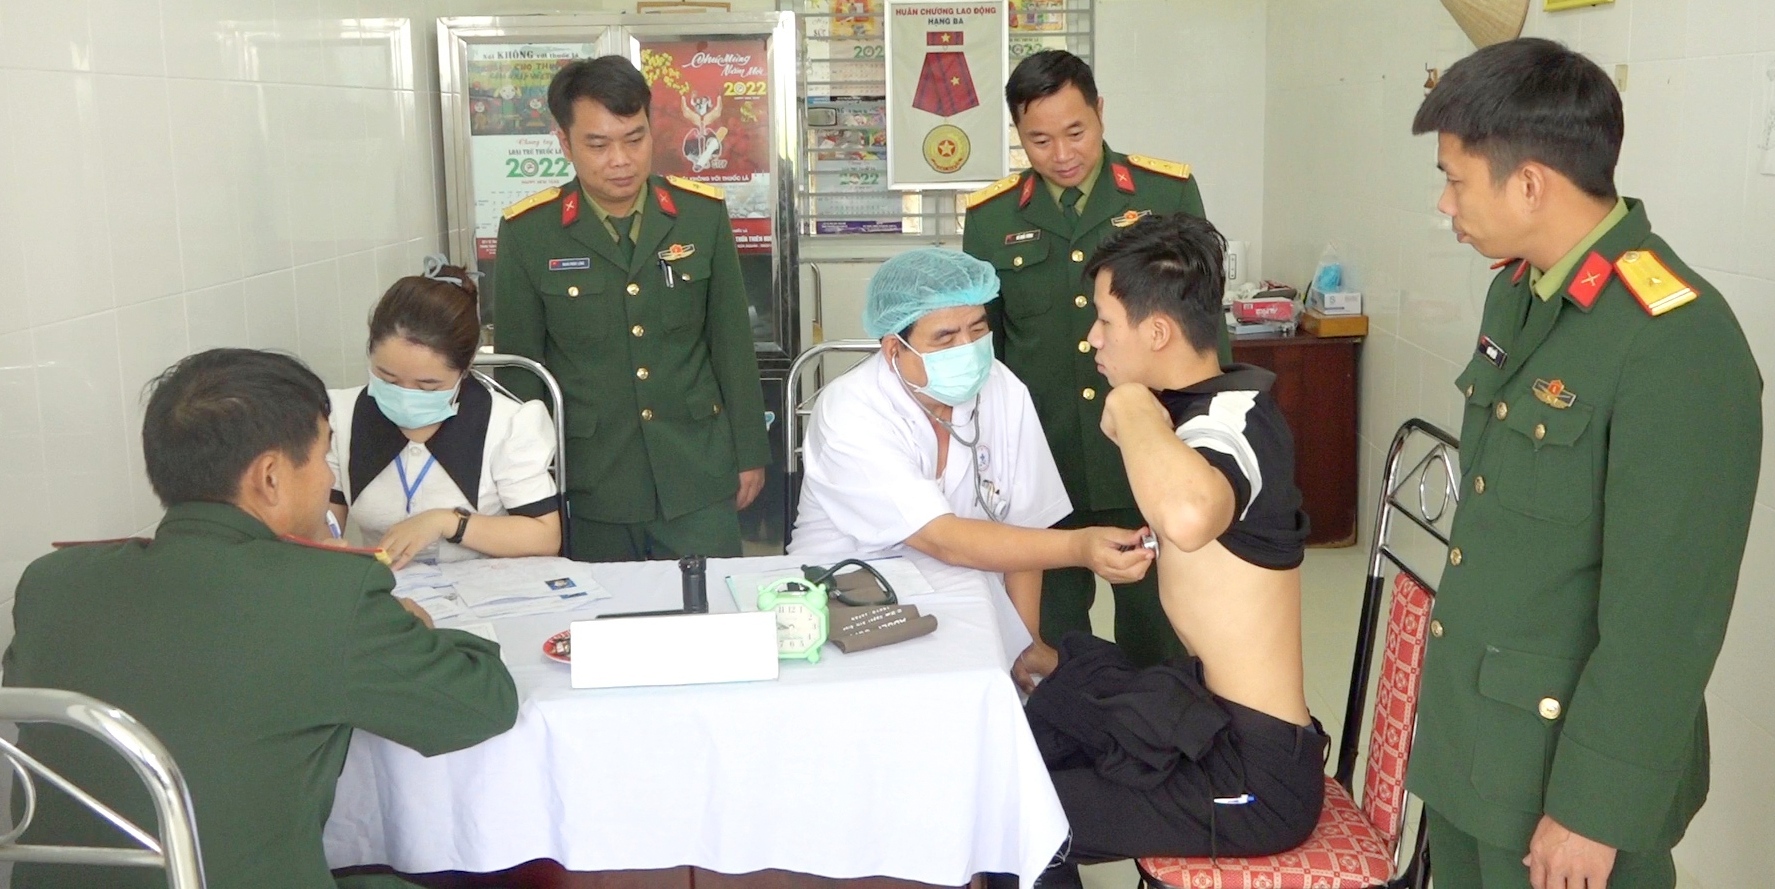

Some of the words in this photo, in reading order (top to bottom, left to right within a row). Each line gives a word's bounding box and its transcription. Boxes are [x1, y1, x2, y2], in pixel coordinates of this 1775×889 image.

[973, 6, 997, 16] ĐỘNG
[928, 17, 951, 27] HẠNG
[952, 17, 964, 25] BA
[497, 49, 534, 59] KHÔNG
[853, 45, 884, 59] 202
[723, 81, 766, 96] 2022
[505, 157, 569, 178] 2022
